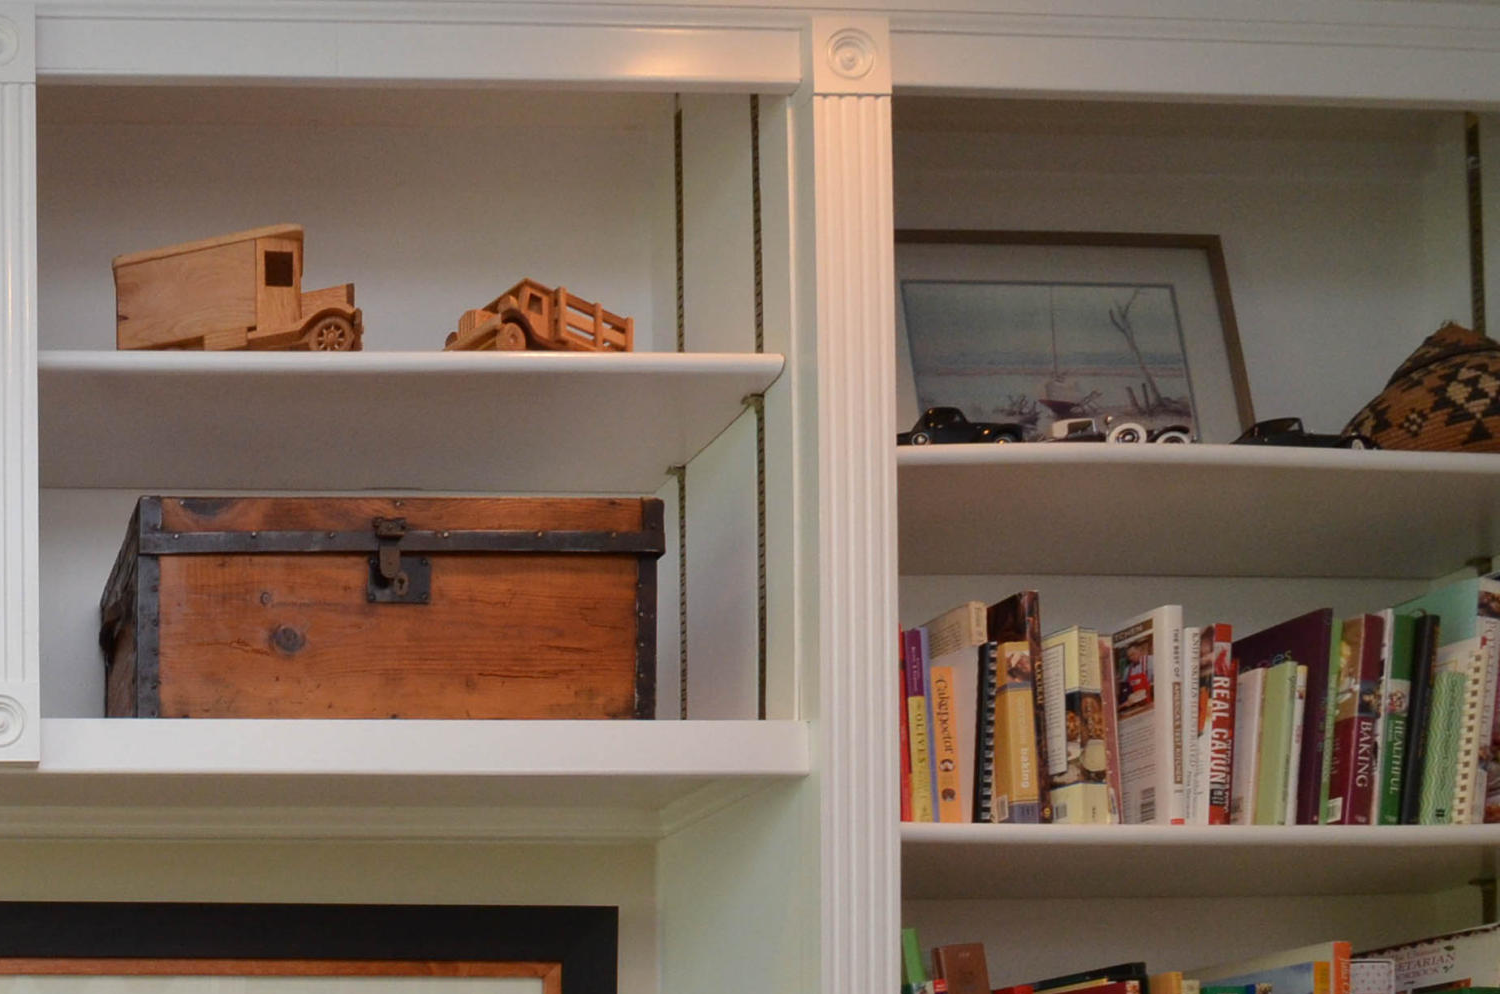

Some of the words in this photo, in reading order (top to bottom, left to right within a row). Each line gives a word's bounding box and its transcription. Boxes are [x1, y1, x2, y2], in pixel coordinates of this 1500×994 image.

[1174, 670, 1181, 679] OF
[1211, 677, 1232, 721] REAL
[914, 712, 926, 765] OLIVES
[1209, 727, 1232, 784] CAJUN
[1355, 720, 1373, 788] BAKING
[1389, 720, 1405, 795] HEALTHFUL
[1019, 748, 1032, 789] baking
